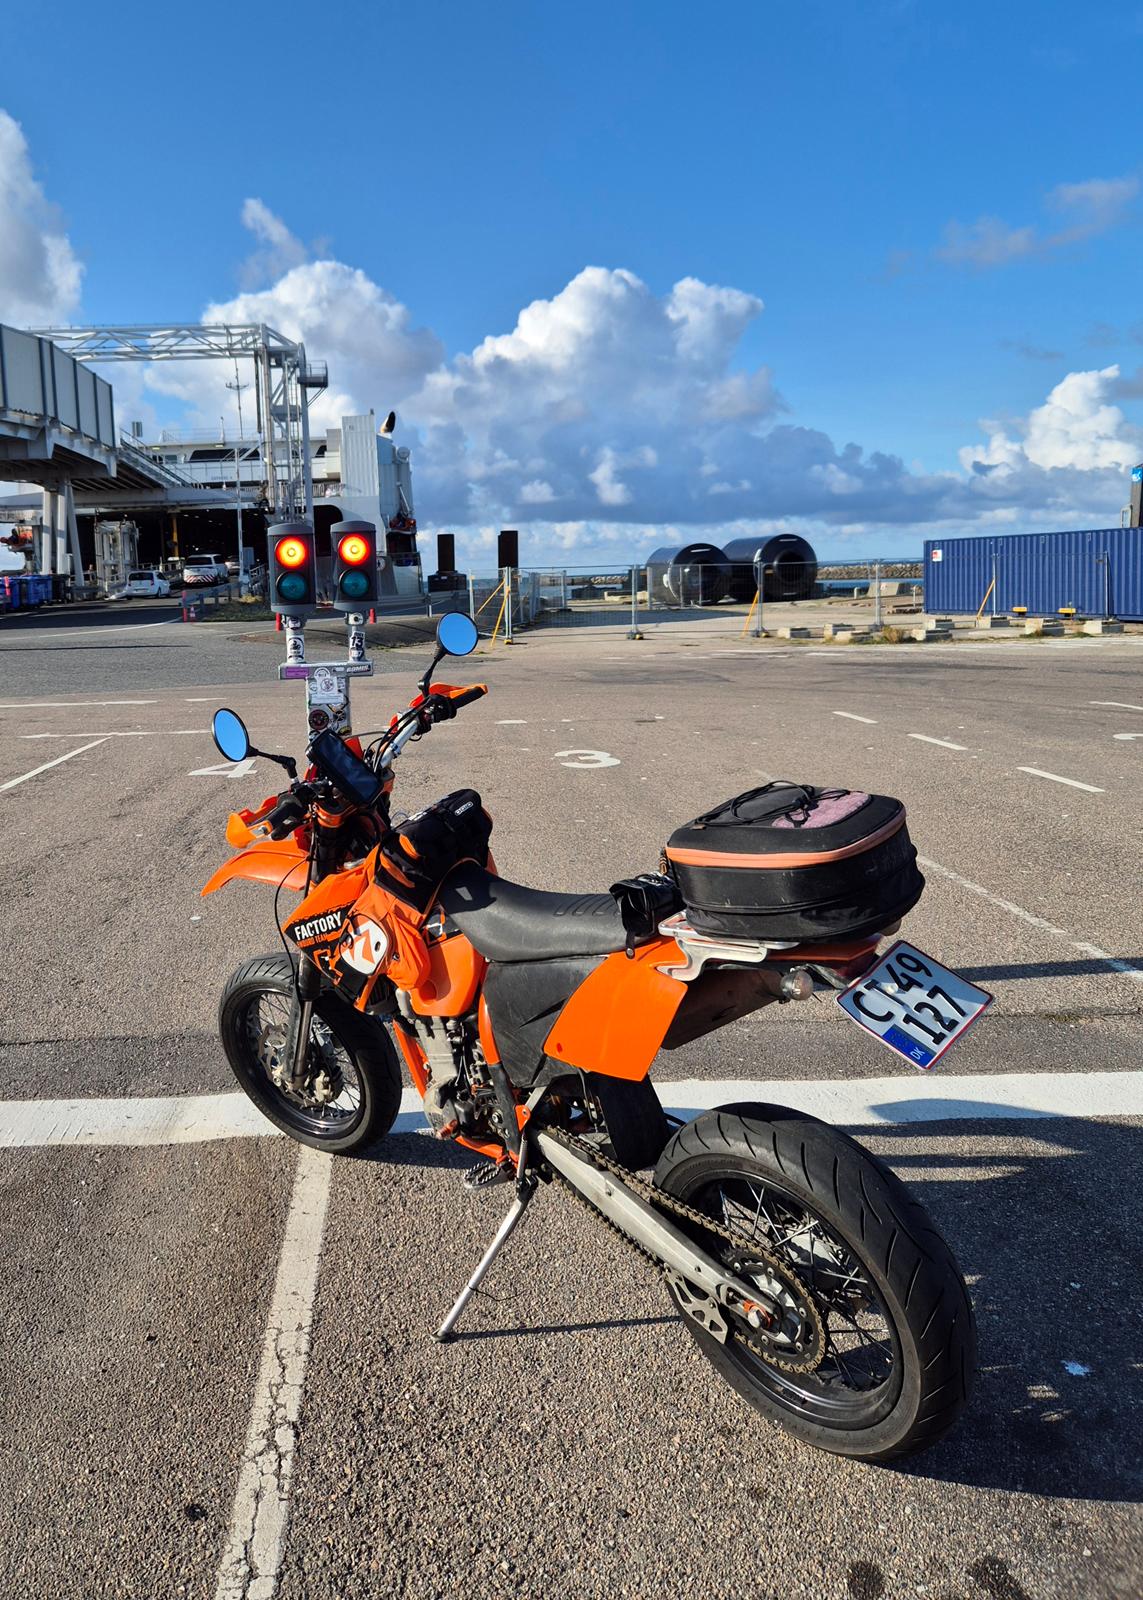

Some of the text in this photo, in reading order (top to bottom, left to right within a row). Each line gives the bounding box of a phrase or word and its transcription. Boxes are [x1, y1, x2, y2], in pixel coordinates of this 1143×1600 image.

[187, 759, 257, 779] 4
[554, 749, 622, 769] 3
[294, 911, 342, 941] FACTORY
[853, 953, 932, 1022] CT 49
[903, 985, 966, 1044] 127
[910, 1047, 925, 1060] DK
